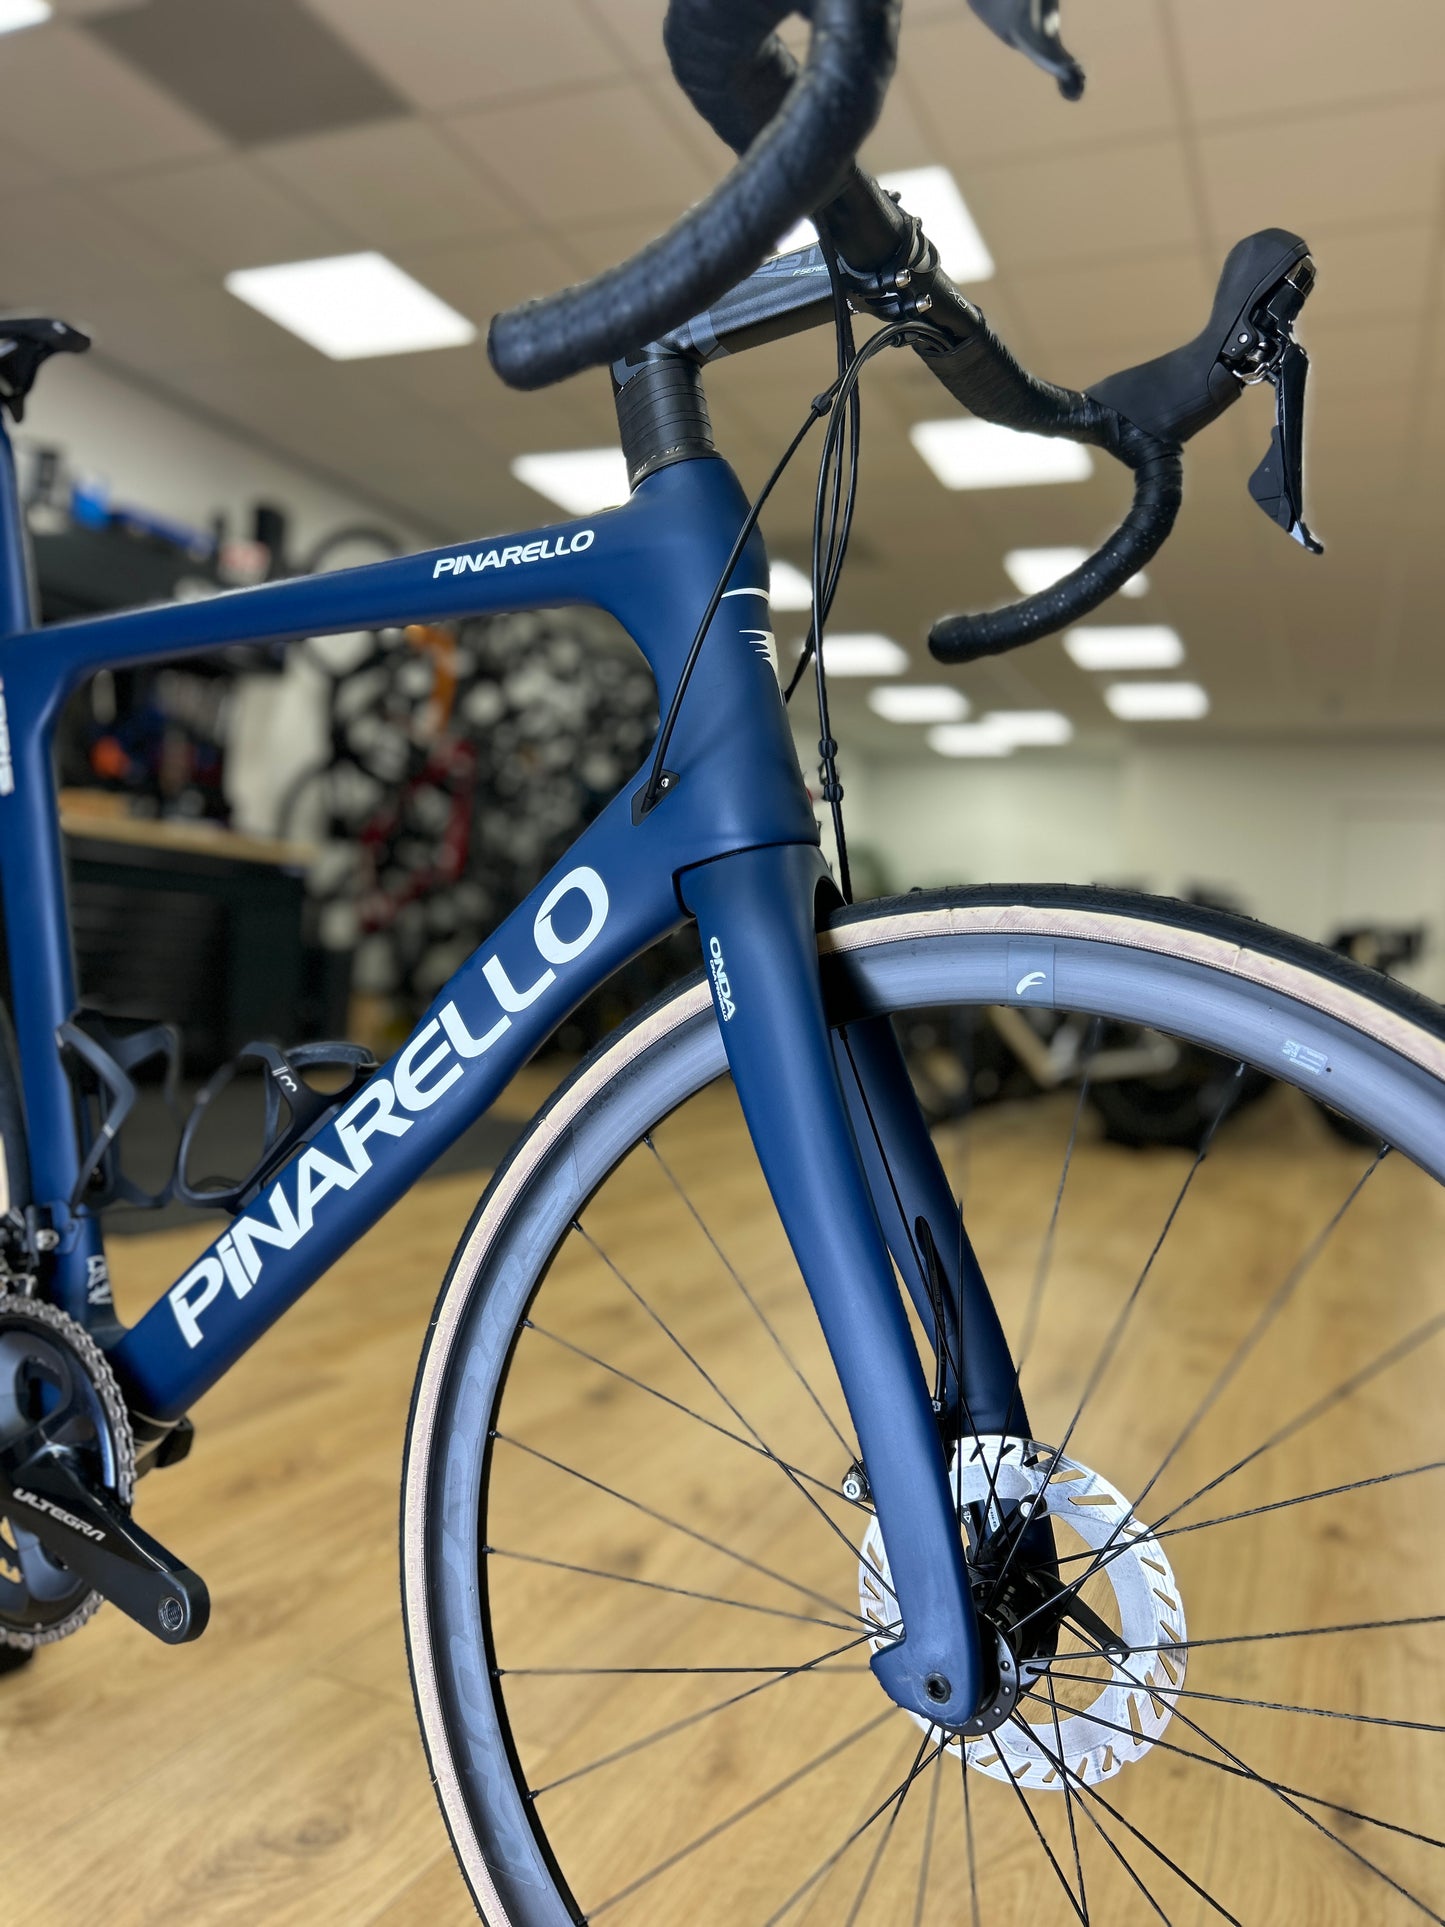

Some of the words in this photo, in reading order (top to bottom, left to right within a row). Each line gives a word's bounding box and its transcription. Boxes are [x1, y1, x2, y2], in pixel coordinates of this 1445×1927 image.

[432, 529, 595, 579] PINARELLO
[709, 936, 736, 1020] ONDA
[168, 866, 610, 1348] PINARELLO
[13, 1487, 107, 1541] ULTEGRA
